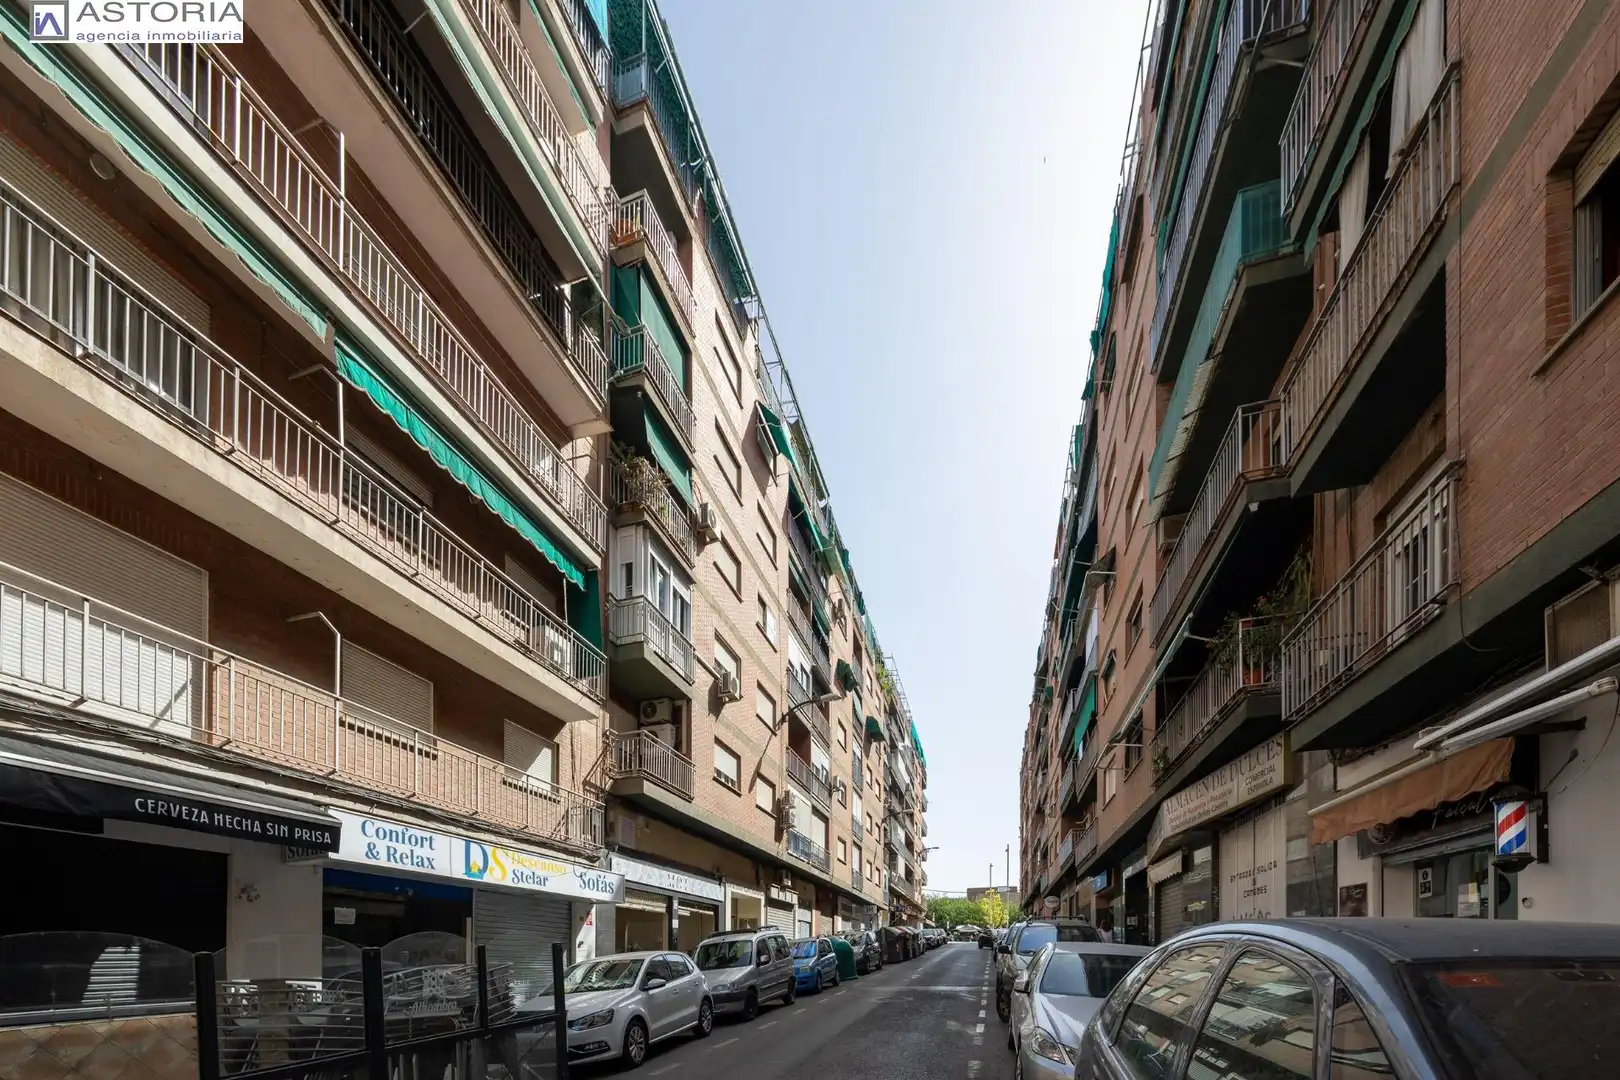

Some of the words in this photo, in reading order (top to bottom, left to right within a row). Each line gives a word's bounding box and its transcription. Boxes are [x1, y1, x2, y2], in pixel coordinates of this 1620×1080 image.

[1230, 738, 1283, 782] DULCES
[134, 797, 210, 825] CERVEZA
[213, 812, 262, 834] HECHA
[266, 822, 289, 838] SIN
[294, 827, 332, 845] PRISA
[361, 819, 436, 851] Confort
[365, 841, 381, 861] &
[386, 845, 436, 870] Relax
[511, 868, 549, 887] Stelar
[579, 871, 615, 895] Sofás
